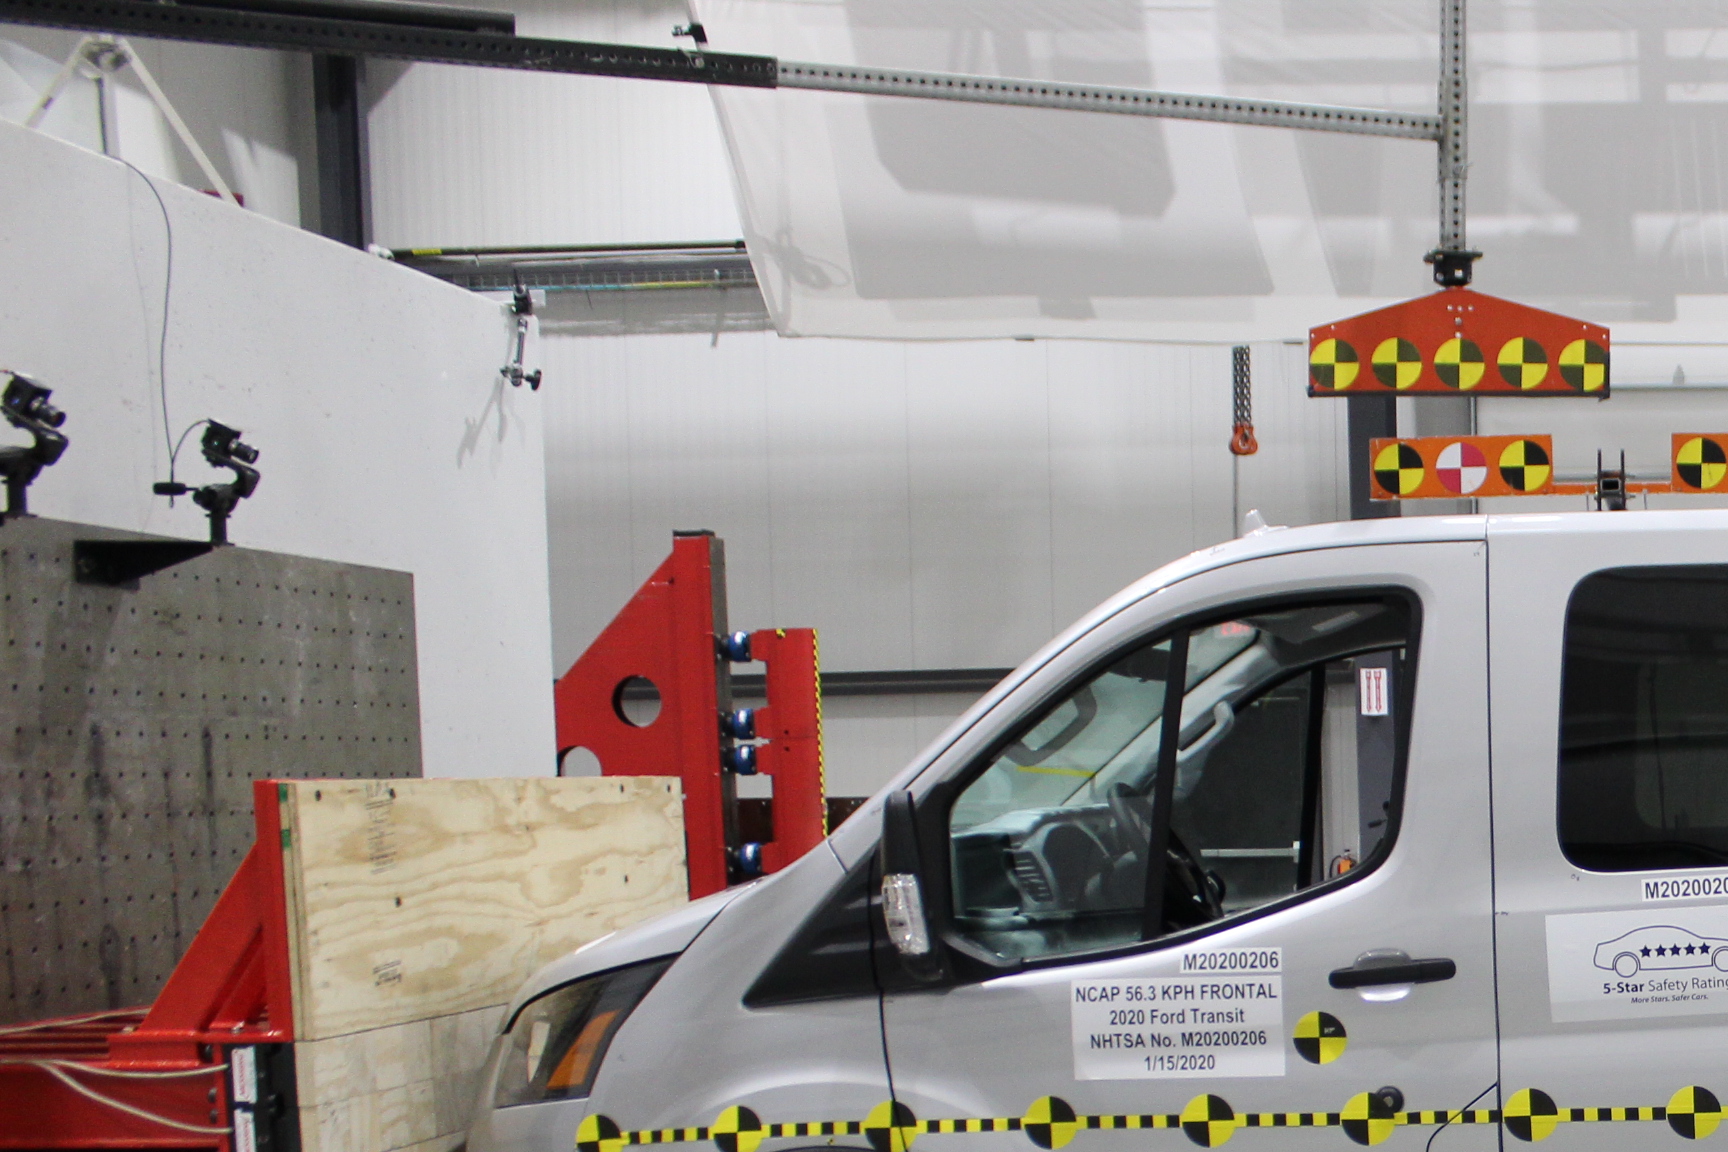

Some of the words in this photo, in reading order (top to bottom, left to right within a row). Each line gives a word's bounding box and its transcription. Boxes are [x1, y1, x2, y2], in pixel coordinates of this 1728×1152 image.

[1182, 951, 1279, 971] M20200206
[1075, 986, 1121, 1003] NCAP
[1125, 985, 1156, 1001] 56.3
[1161, 984, 1195, 1001] KPH
[1200, 983, 1277, 1000] FRONTAL
[1603, 981, 1645, 994] 5-Star
[1648, 978, 1688, 993] Safety
[1631, 996, 1649, 1004] More
[1671, 994, 1690, 1002] Safer
[1109, 1010, 1145, 1026] 2020
[1150, 1009, 1185, 1025] Ford
[1190, 1007, 1245, 1024] Transit
[1090, 1033, 1145, 1049] NHTSA
[1151, 1032, 1177, 1048] No.
[1181, 1031, 1267, 1048] M20200206
[1144, 1054, 1216, 1071] 1/15/2020
